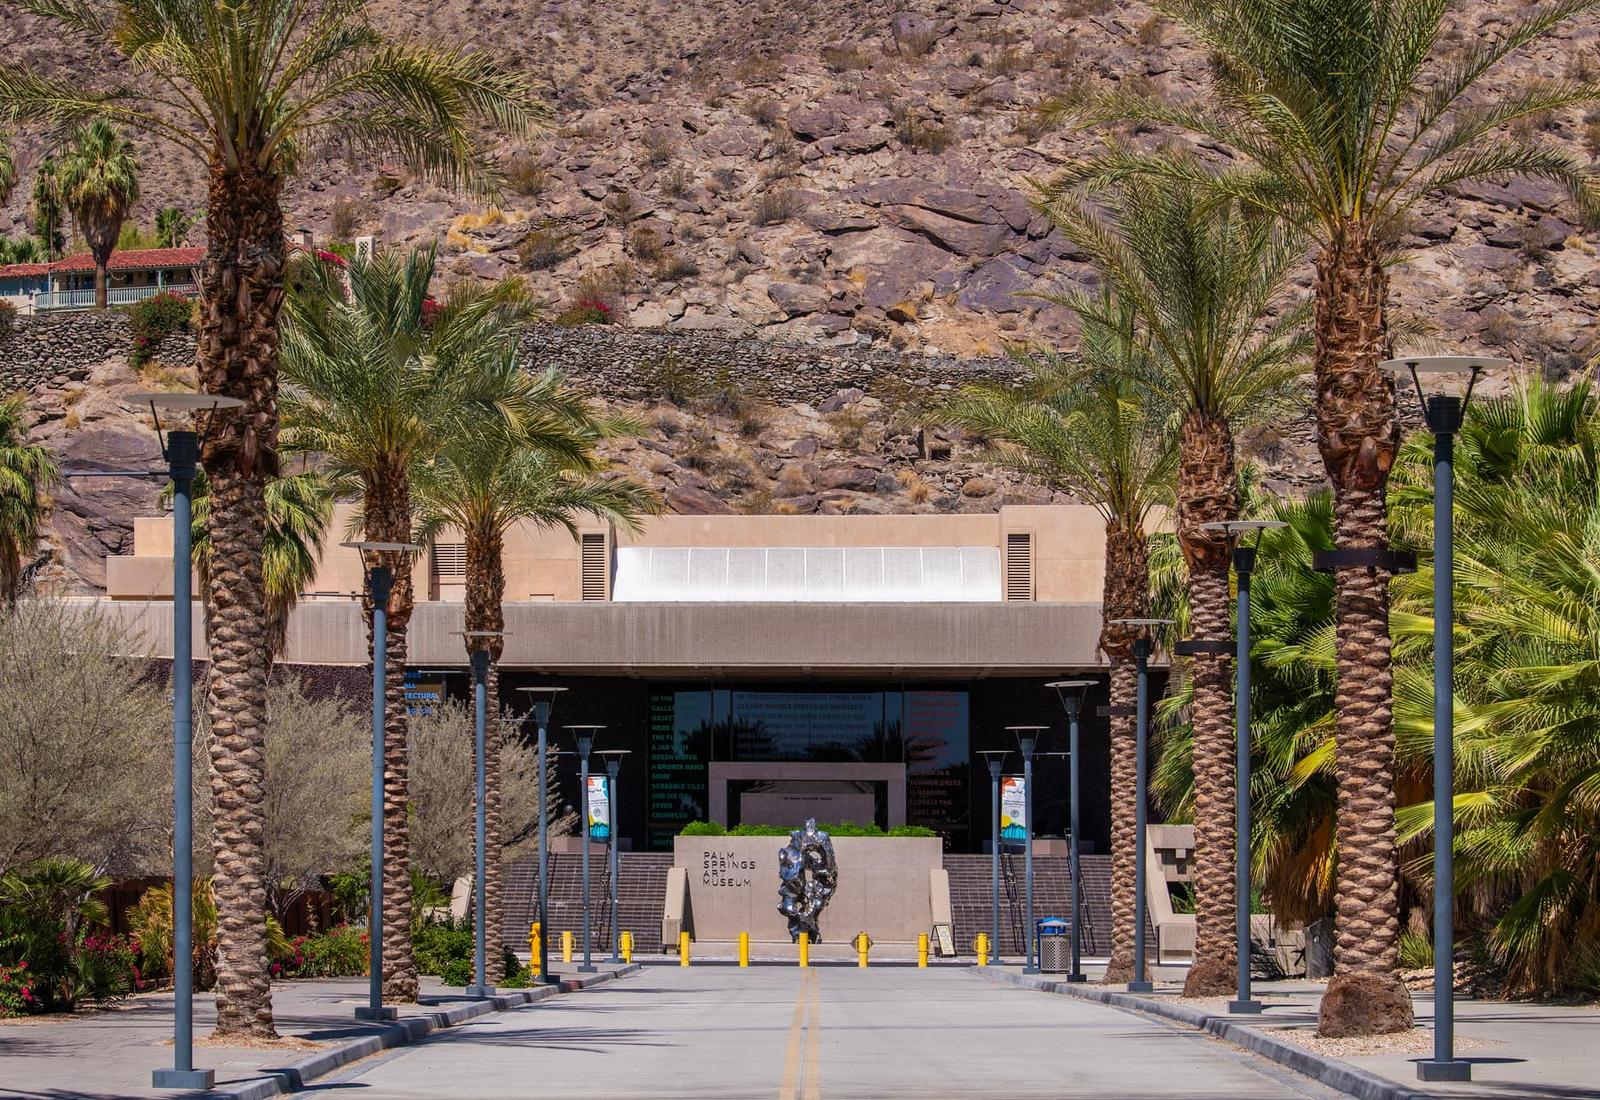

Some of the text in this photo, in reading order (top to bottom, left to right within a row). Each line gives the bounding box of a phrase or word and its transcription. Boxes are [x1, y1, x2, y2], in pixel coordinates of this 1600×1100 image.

[704, 852, 734, 860] PALM
[704, 861, 756, 869] SPRINGS
[703, 878, 751, 887] MUSEUM
